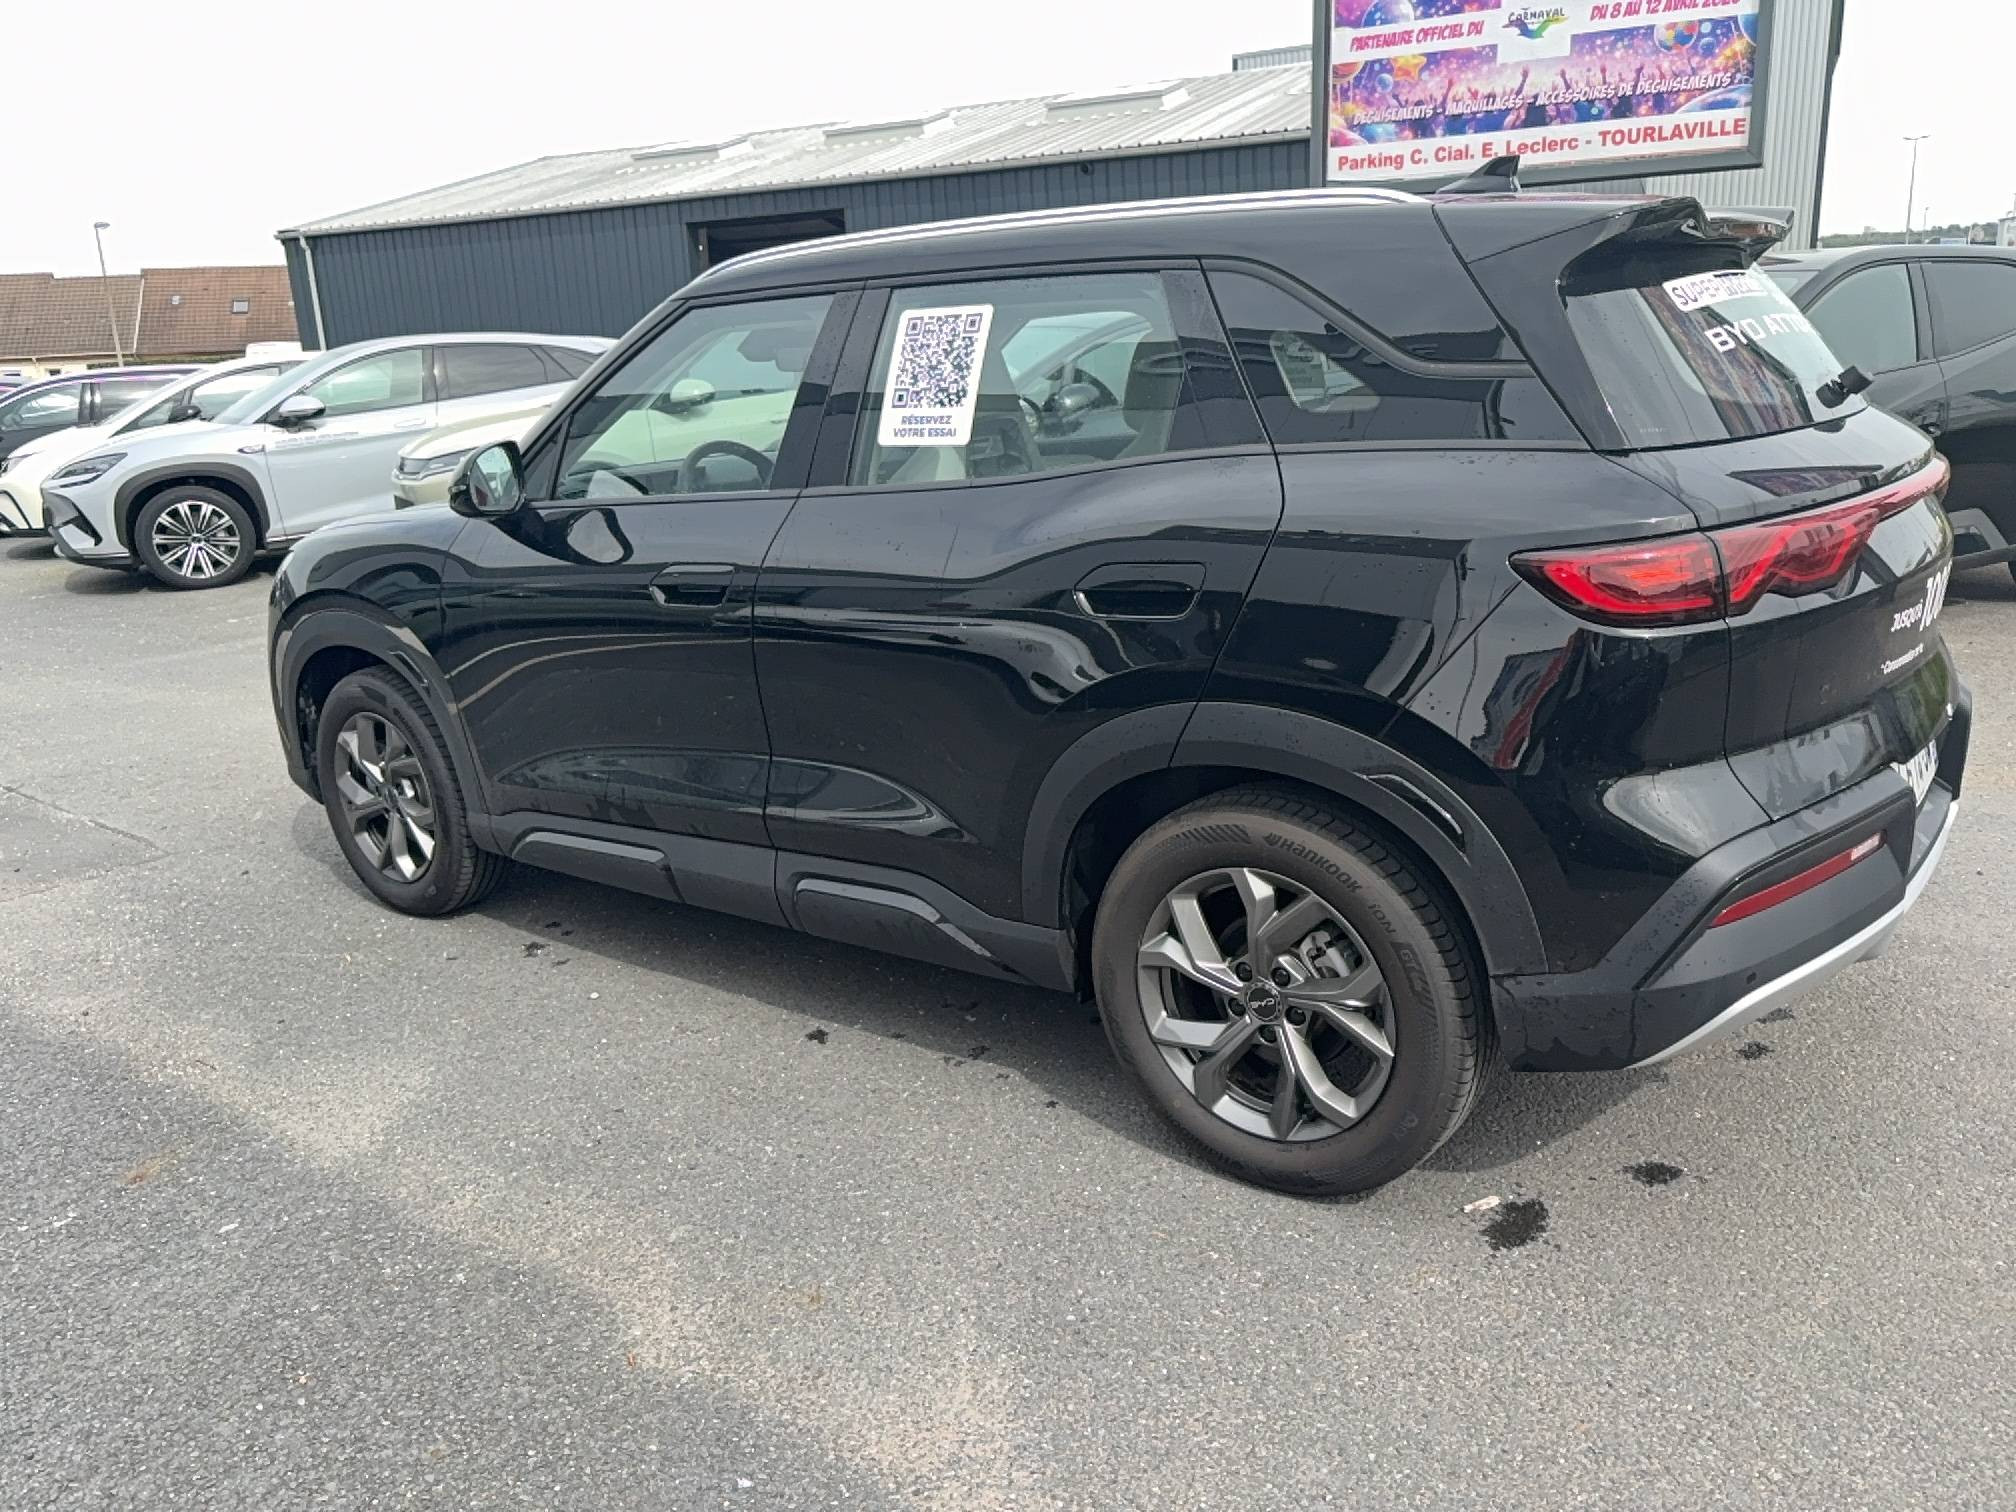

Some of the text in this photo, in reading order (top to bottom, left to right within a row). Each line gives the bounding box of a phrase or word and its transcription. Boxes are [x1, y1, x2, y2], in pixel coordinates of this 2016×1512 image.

[1589, 4, 1609, 20] DU
[1610, 2, 1622, 19] 8
[1622, 1, 1642, 18] AU
[1645, 0, 1662, 14] 12
[1350, 20, 1485, 52] PARTENAIRE OFFICIEL DU
[1446, 95, 1524, 116] MAQUILLAGES
[1535, 85, 1615, 106] ACCESSOIRES
[1618, 82, 1636, 97] DE
[1338, 151, 1405, 171] Parking
[1410, 149, 1428, 166] C.
[1434, 145, 1475, 163] Cial.
[1481, 142, 1499, 159] E.
[1506, 135, 1579, 156] Leclerc
[1598, 117, 1747, 147] TOURLAVILLE
[1704, 319, 1767, 353] BYD
[893, 427, 957, 438] VOTRE ESSAI
[901, 414, 953, 425] RÉSERVEZ
